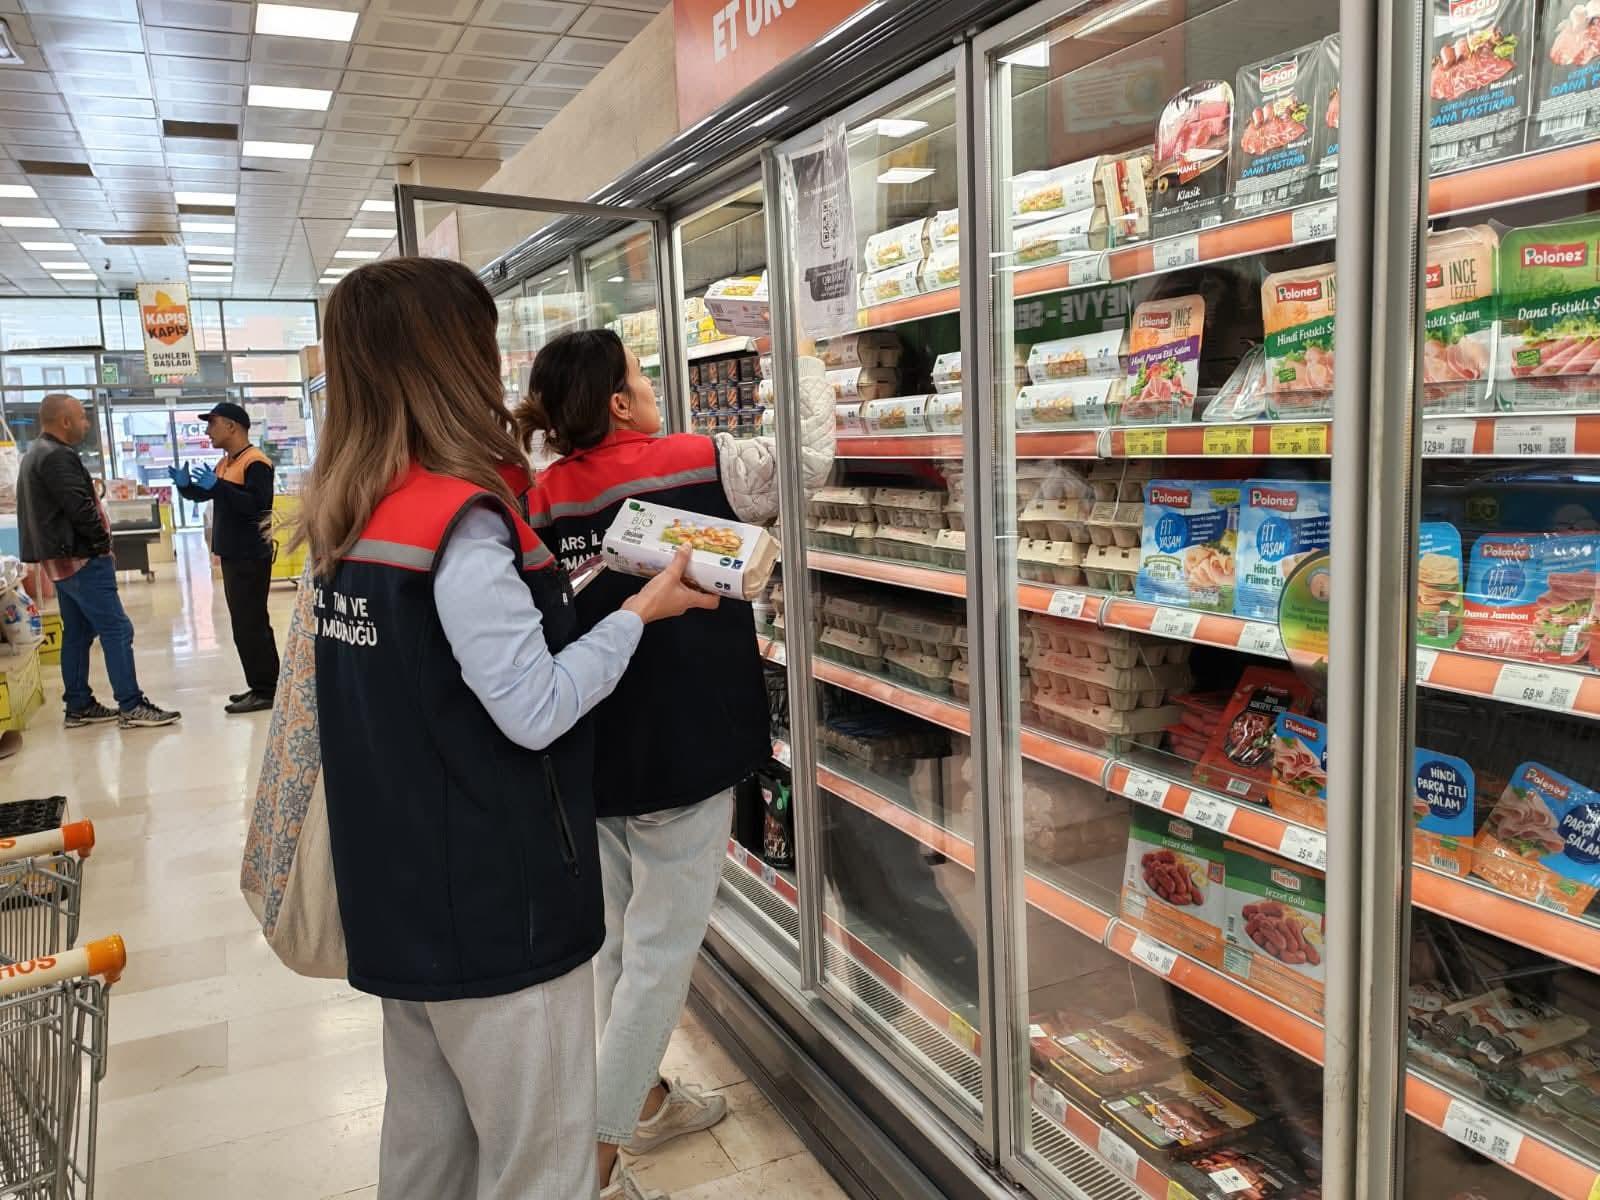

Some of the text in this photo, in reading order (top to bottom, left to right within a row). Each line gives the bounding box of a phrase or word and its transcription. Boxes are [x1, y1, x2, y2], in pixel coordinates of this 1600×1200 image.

[712, 2, 740, 64] ET
[1176, 187, 1201, 202] Klasik
[1524, 247, 1585, 266] Polonez
[1425, 272, 1440, 283] ez
[1449, 258, 1477, 284] İNCE
[1278, 286, 1318, 301] Polonez
[1450, 285, 1477, 299] LEZZET
[1449, 309, 1480, 325] Salam
[1517, 306, 1548, 321] Dana
[1277, 330, 1298, 347] Hindi
[1151, 489, 1190, 505] Polonez
[1252, 490, 1296, 507] Polonez
[561, 536, 586, 552] ARS
[1483, 543, 1527, 558] Polonez
[1253, 563, 1277, 576] Hindi
[350, 597, 369, 617] VE
[1463, 608, 1529, 621] Dana Jambon
[1285, 719, 1318, 738] Polonez
[1430, 765, 1456, 783] HİNDİ
[1417, 777, 1467, 799] PARÇA ETLİ
[1525, 768, 1568, 798] Polonez
[1564, 813, 1596, 837] PARÇA
